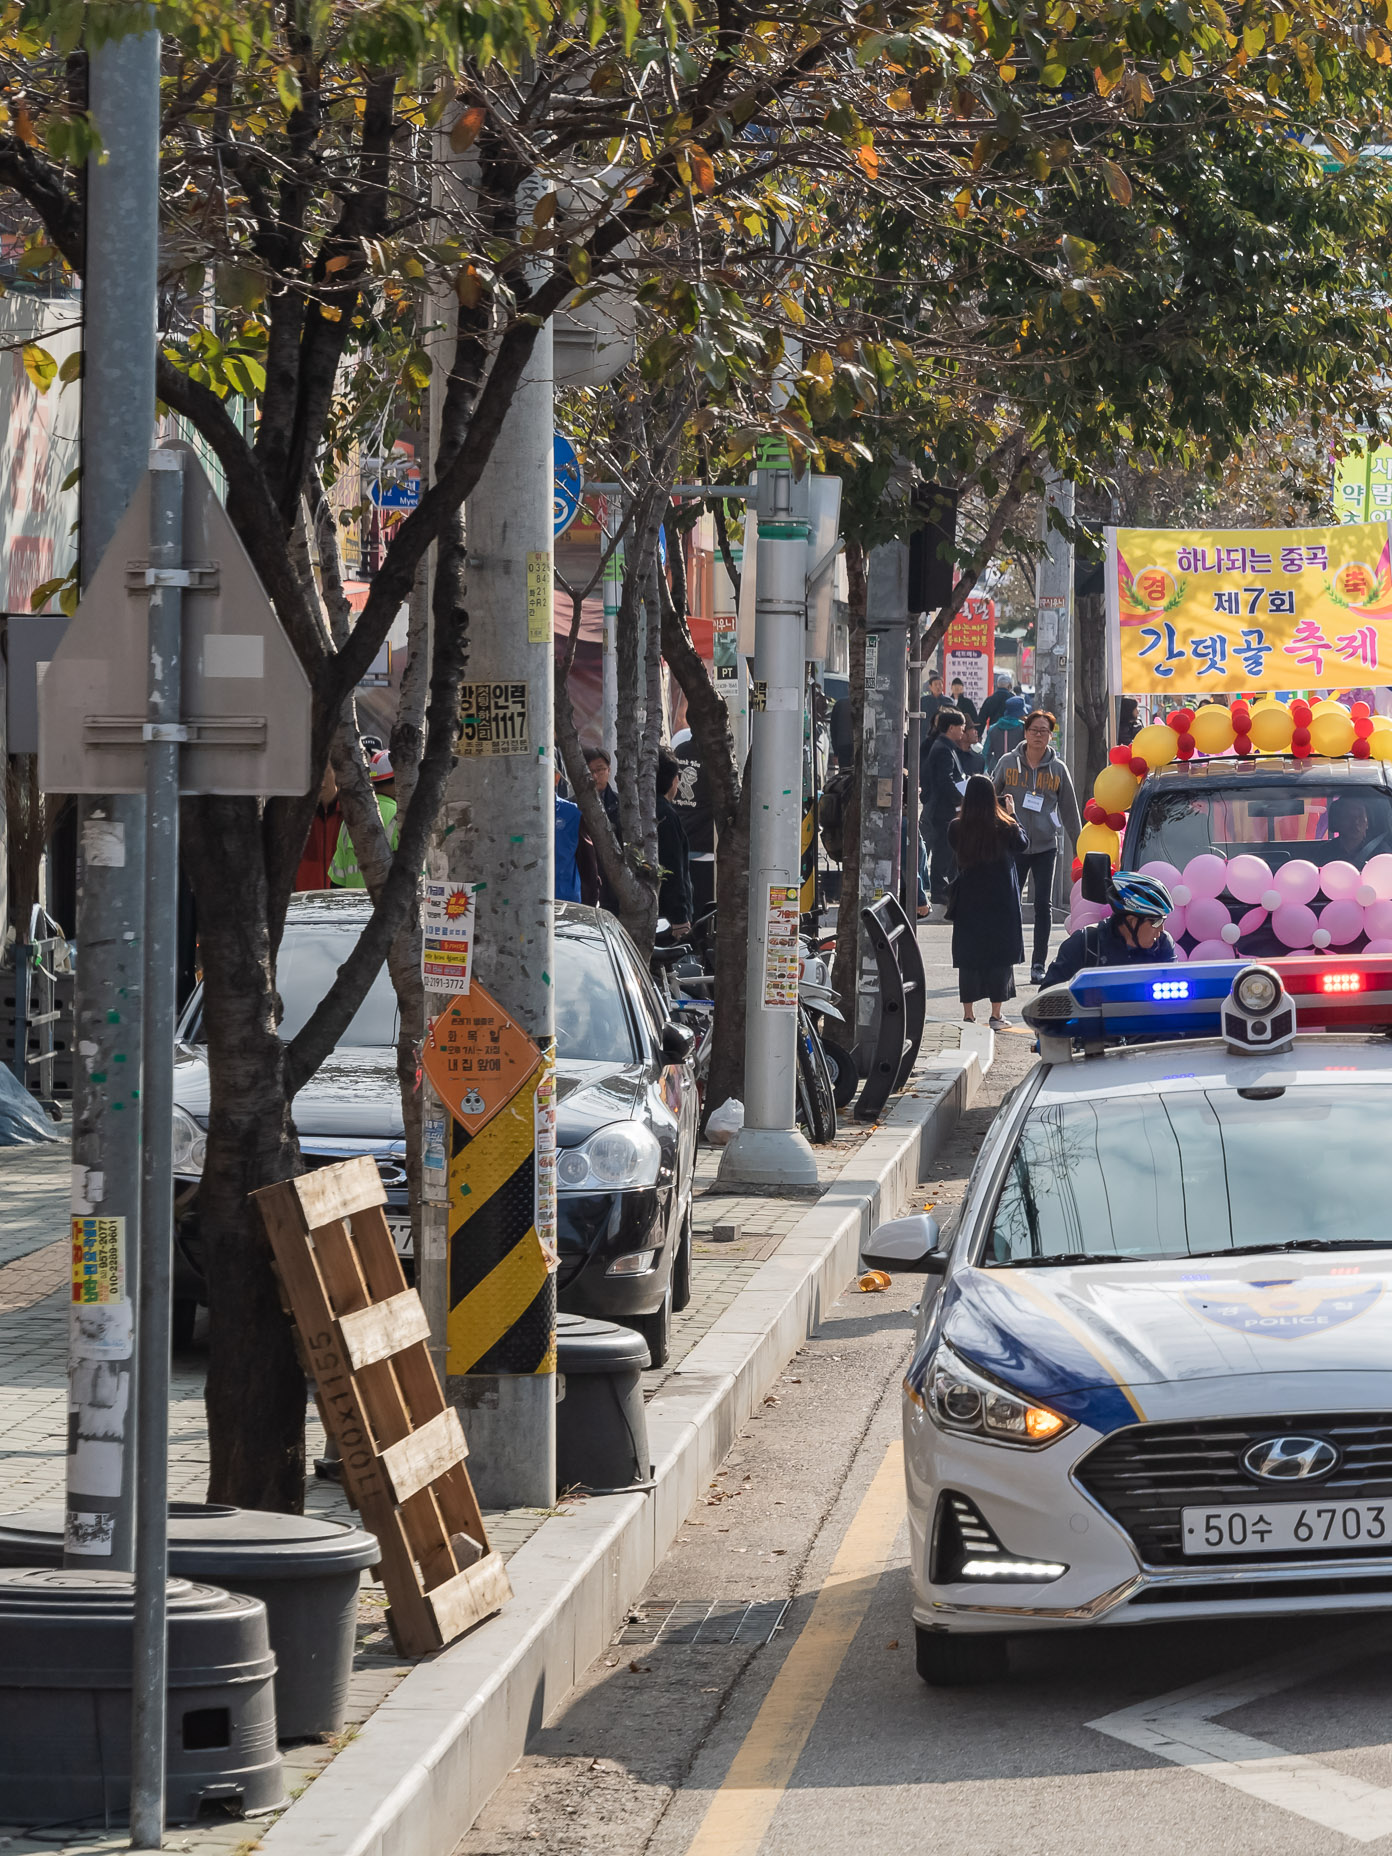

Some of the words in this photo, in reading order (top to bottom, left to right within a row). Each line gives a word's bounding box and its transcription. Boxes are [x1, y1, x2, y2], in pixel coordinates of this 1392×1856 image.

[1177, 547, 1272, 574] 하나되는
[1280, 545, 1329, 573] 중곡
[1143, 575, 1166, 602] 경
[1343, 571, 1368, 597] 축
[1213, 587, 1295, 616] 제7회
[1283, 620, 1379, 677] 축제
[722, 667, 733, 678] PT
[493, 684, 526, 712] 인력
[493, 711, 526, 740] 1117
[448, 1059, 458, 1071] 내
[462, 1059, 473, 1072] 집
[477, 1058, 500, 1072] 앞에
[1244, 1315, 1330, 1328] POLICE
[1204, 1513, 1273, 1547] 50수
[1293, 1506, 1386, 1542] 6703
